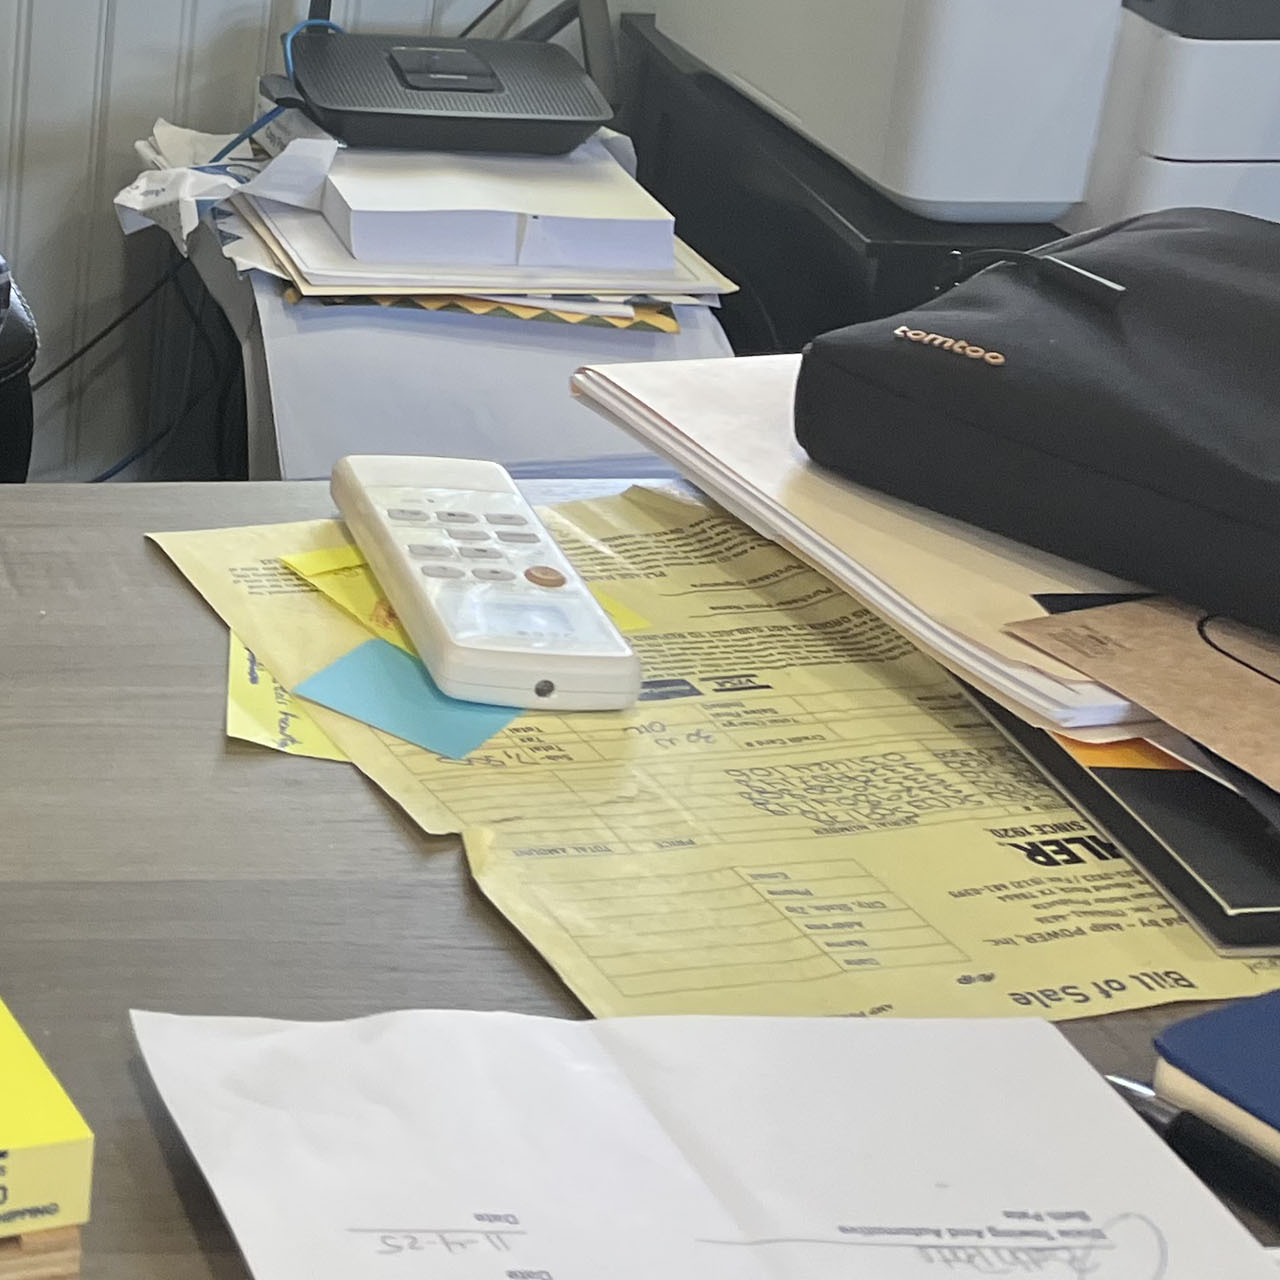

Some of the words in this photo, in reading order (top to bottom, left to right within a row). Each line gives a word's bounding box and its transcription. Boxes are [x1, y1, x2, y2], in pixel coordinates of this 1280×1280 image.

[1031, 821, 1086, 835] SINCE
[566, 843, 613, 855] TOTAL
[654, 838, 696, 848] PRICE
[513, 846, 565, 857] AMOUNT
[1129, 971, 1197, 991] Bill
[1092, 979, 1126, 998] of
[1008, 986, 1090, 1008] Sale
